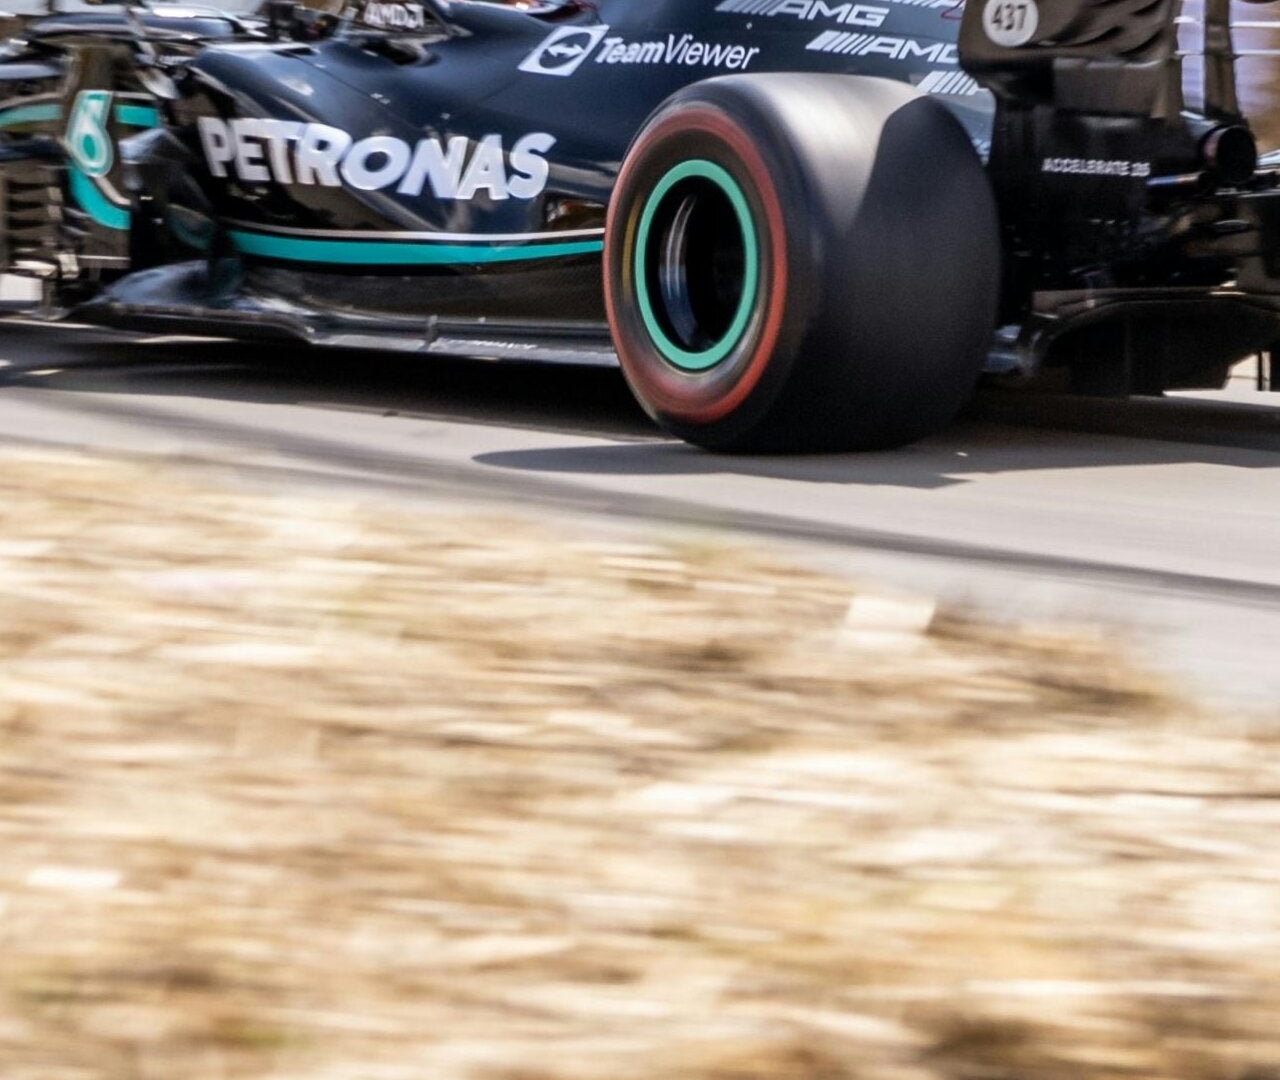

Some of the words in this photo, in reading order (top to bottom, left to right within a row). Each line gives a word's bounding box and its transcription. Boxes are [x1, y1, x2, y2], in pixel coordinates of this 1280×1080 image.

[991, 3, 1028, 32] 437
[594, 33, 760, 70] TeamViewer
[197, 116, 557, 201] PETRONAS
[1041, 157, 1130, 176] ACCELERATE
